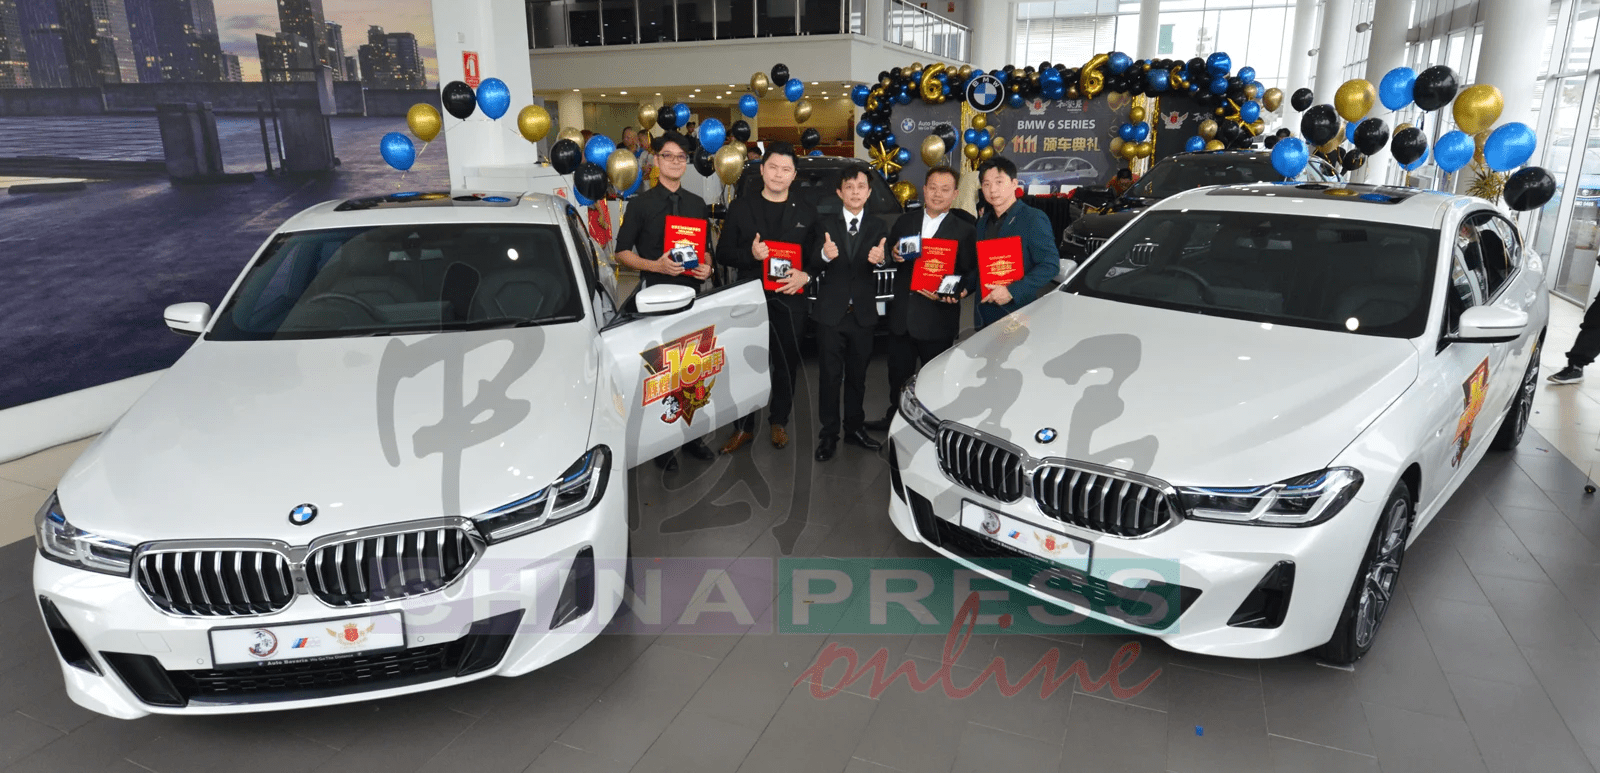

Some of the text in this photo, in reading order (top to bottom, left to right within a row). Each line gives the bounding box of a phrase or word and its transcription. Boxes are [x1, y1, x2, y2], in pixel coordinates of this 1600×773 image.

[921, 62, 945, 103] 6
[1017, 119, 1096, 130] BMW 6 SERIES
[1043, 137, 1101, 152] 颁车典礼
